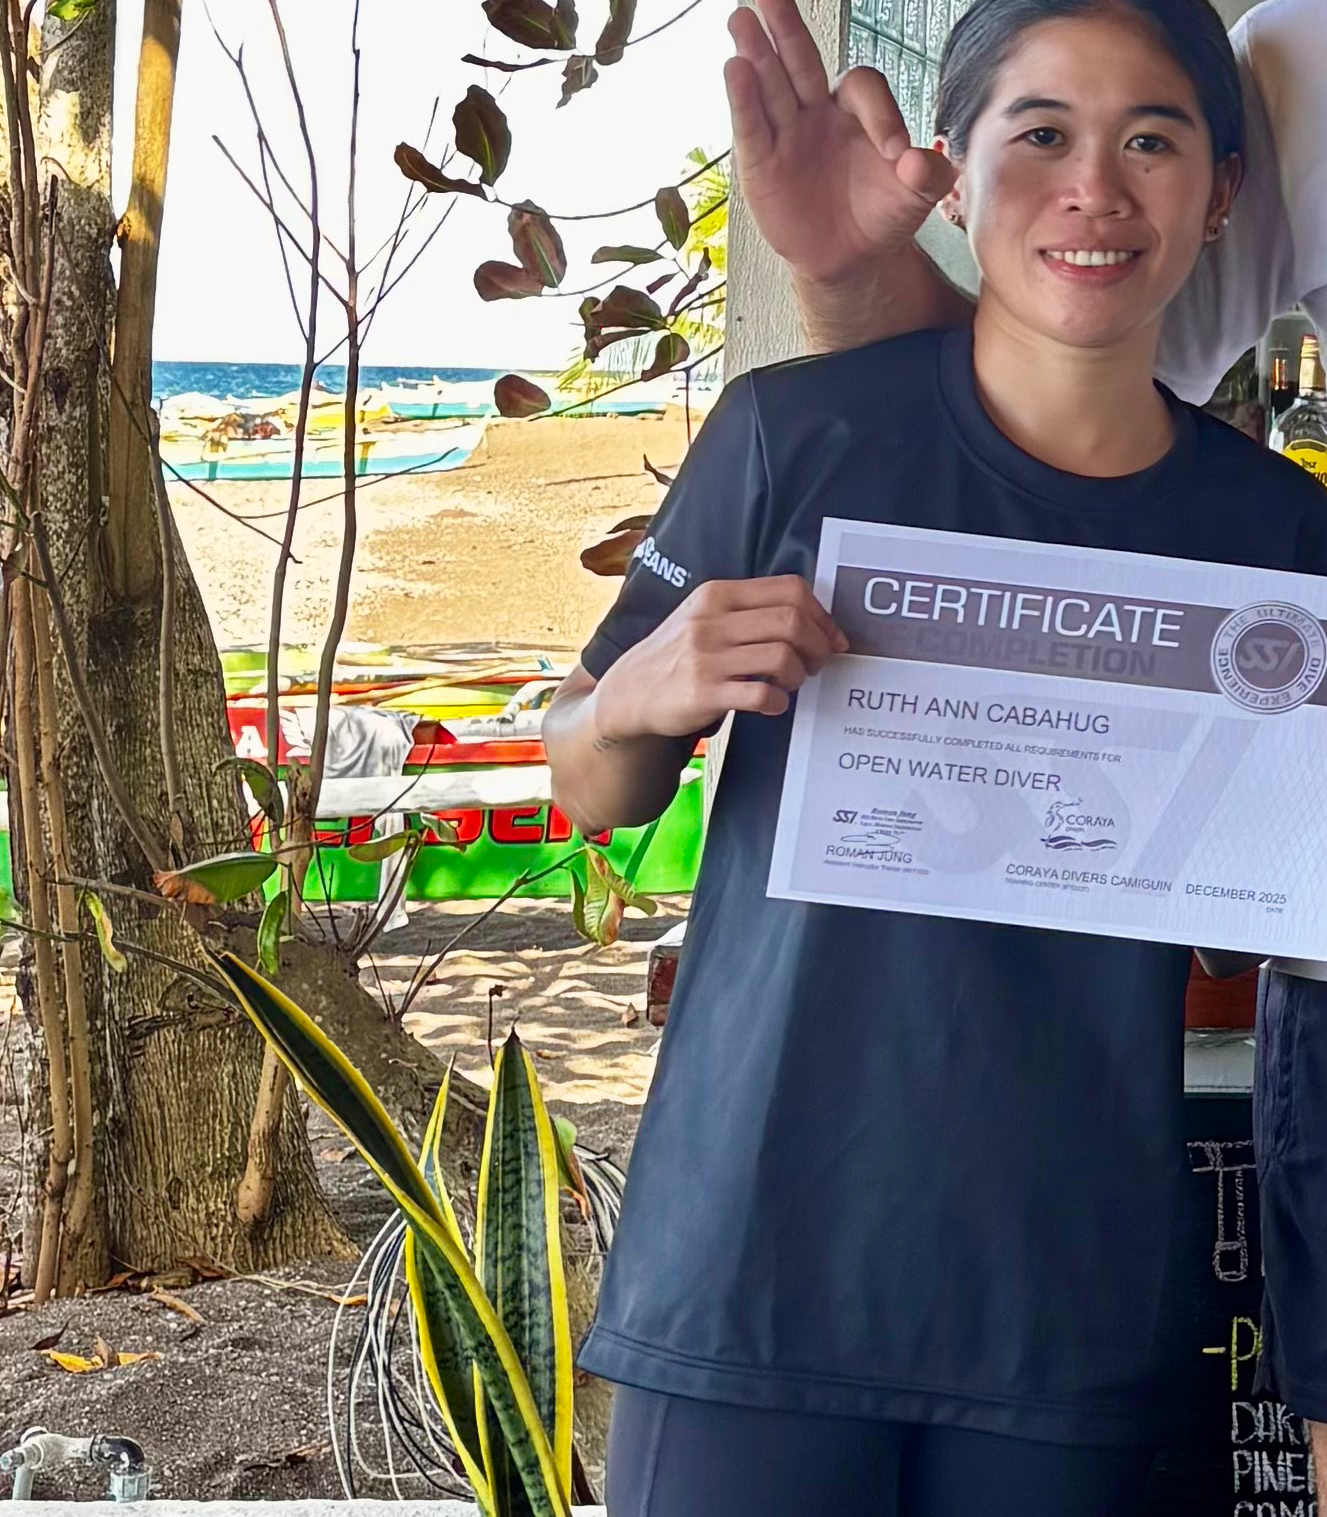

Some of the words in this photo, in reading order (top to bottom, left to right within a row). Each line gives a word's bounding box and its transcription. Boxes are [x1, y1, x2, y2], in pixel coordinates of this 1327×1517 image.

[864, 577, 1185, 648] CERTIFICATE
[847, 689, 918, 714] RUTH
[924, 697, 979, 721] ANN
[987, 703, 1110, 734] CABAHUG
[839, 752, 901, 774] OPEN
[909, 759, 987, 784] WATER
[994, 768, 1061, 791] DIVER
[1066, 814, 1115, 827] CORAYA
[877, 850, 912, 863] JUNG
[1006, 863, 1058, 880] CORAYA
[1062, 870, 1108, 885] DIVERS
[1111, 875, 1172, 892] CAMIGUIN
[1186, 884, 1255, 901] DECEMBER
[1258, 892, 1287, 904] 2025
